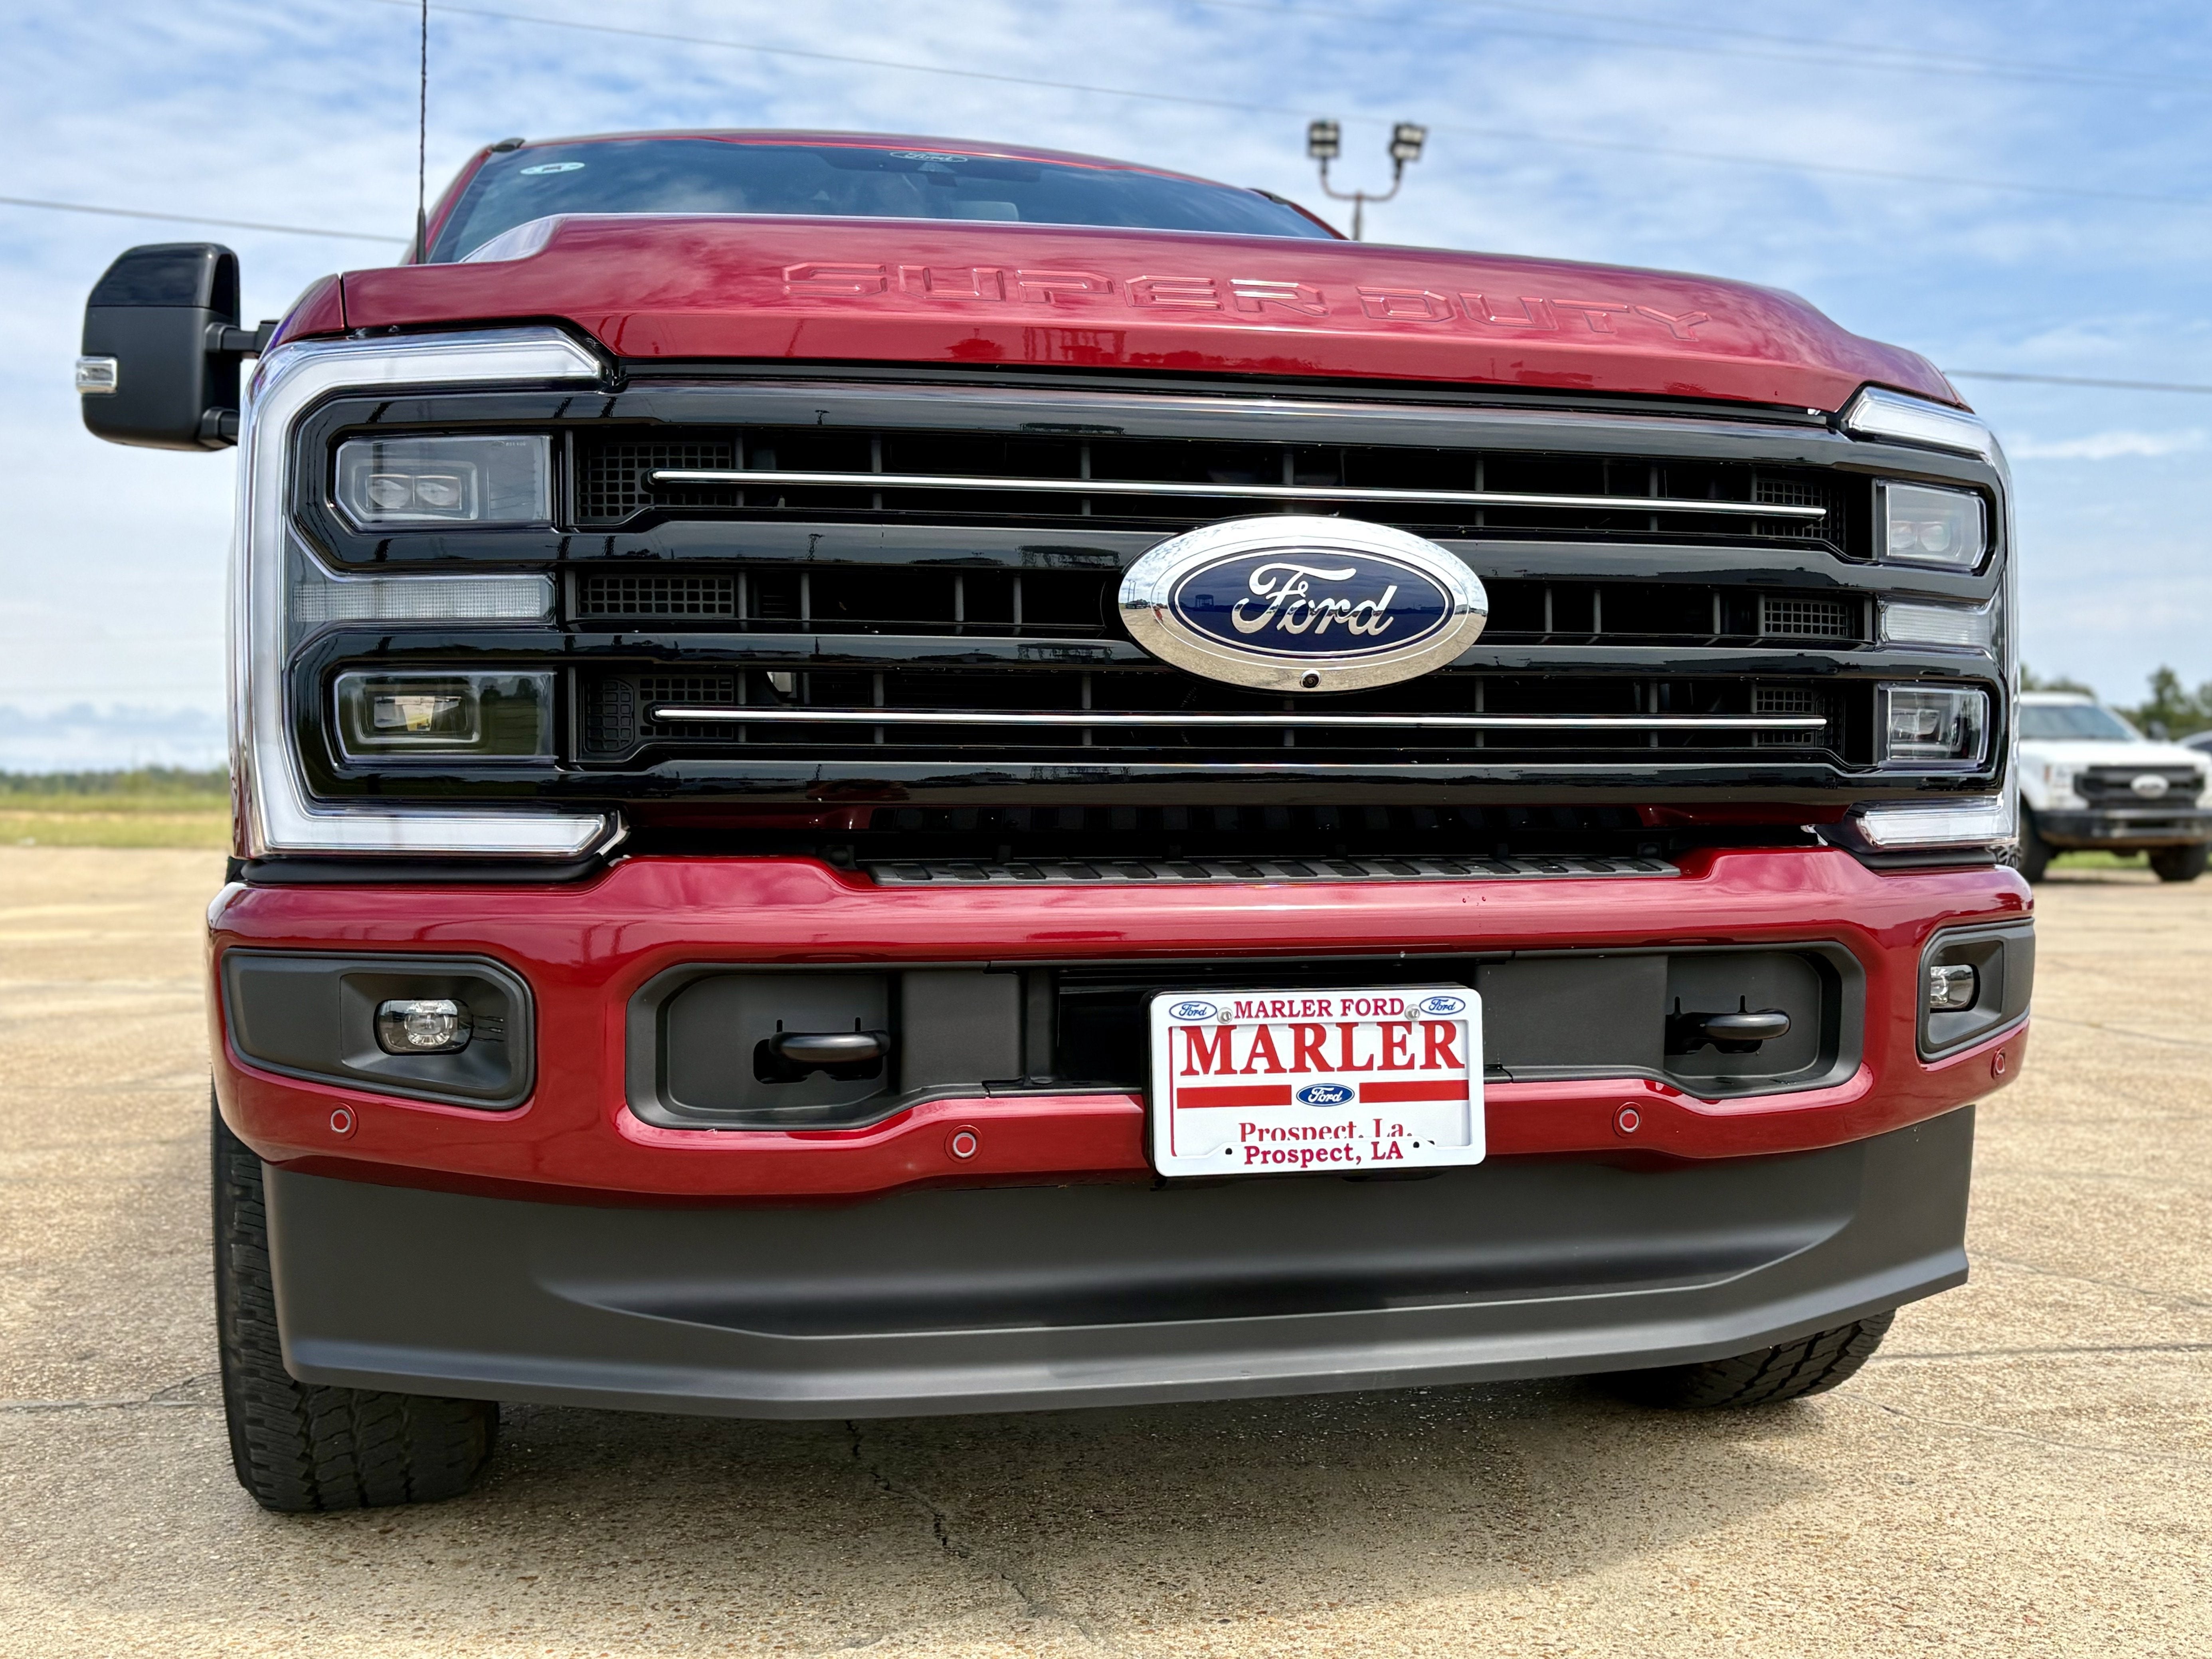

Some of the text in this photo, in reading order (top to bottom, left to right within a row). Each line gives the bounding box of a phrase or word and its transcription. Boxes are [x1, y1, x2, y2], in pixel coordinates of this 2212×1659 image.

[782, 261, 1711, 342] SUPER DUTY
[1231, 562, 1398, 635] Ford
[1179, 1004, 1207, 1016] Ford
[1234, 998, 1404, 1019] MARLER FORD
[1428, 998, 1456, 1011] Ford
[1180, 1020, 1465, 1076] MARLER
[1308, 1086, 1343, 1103] Ford
[1244, 1141, 1403, 1168] Prospect, LA
